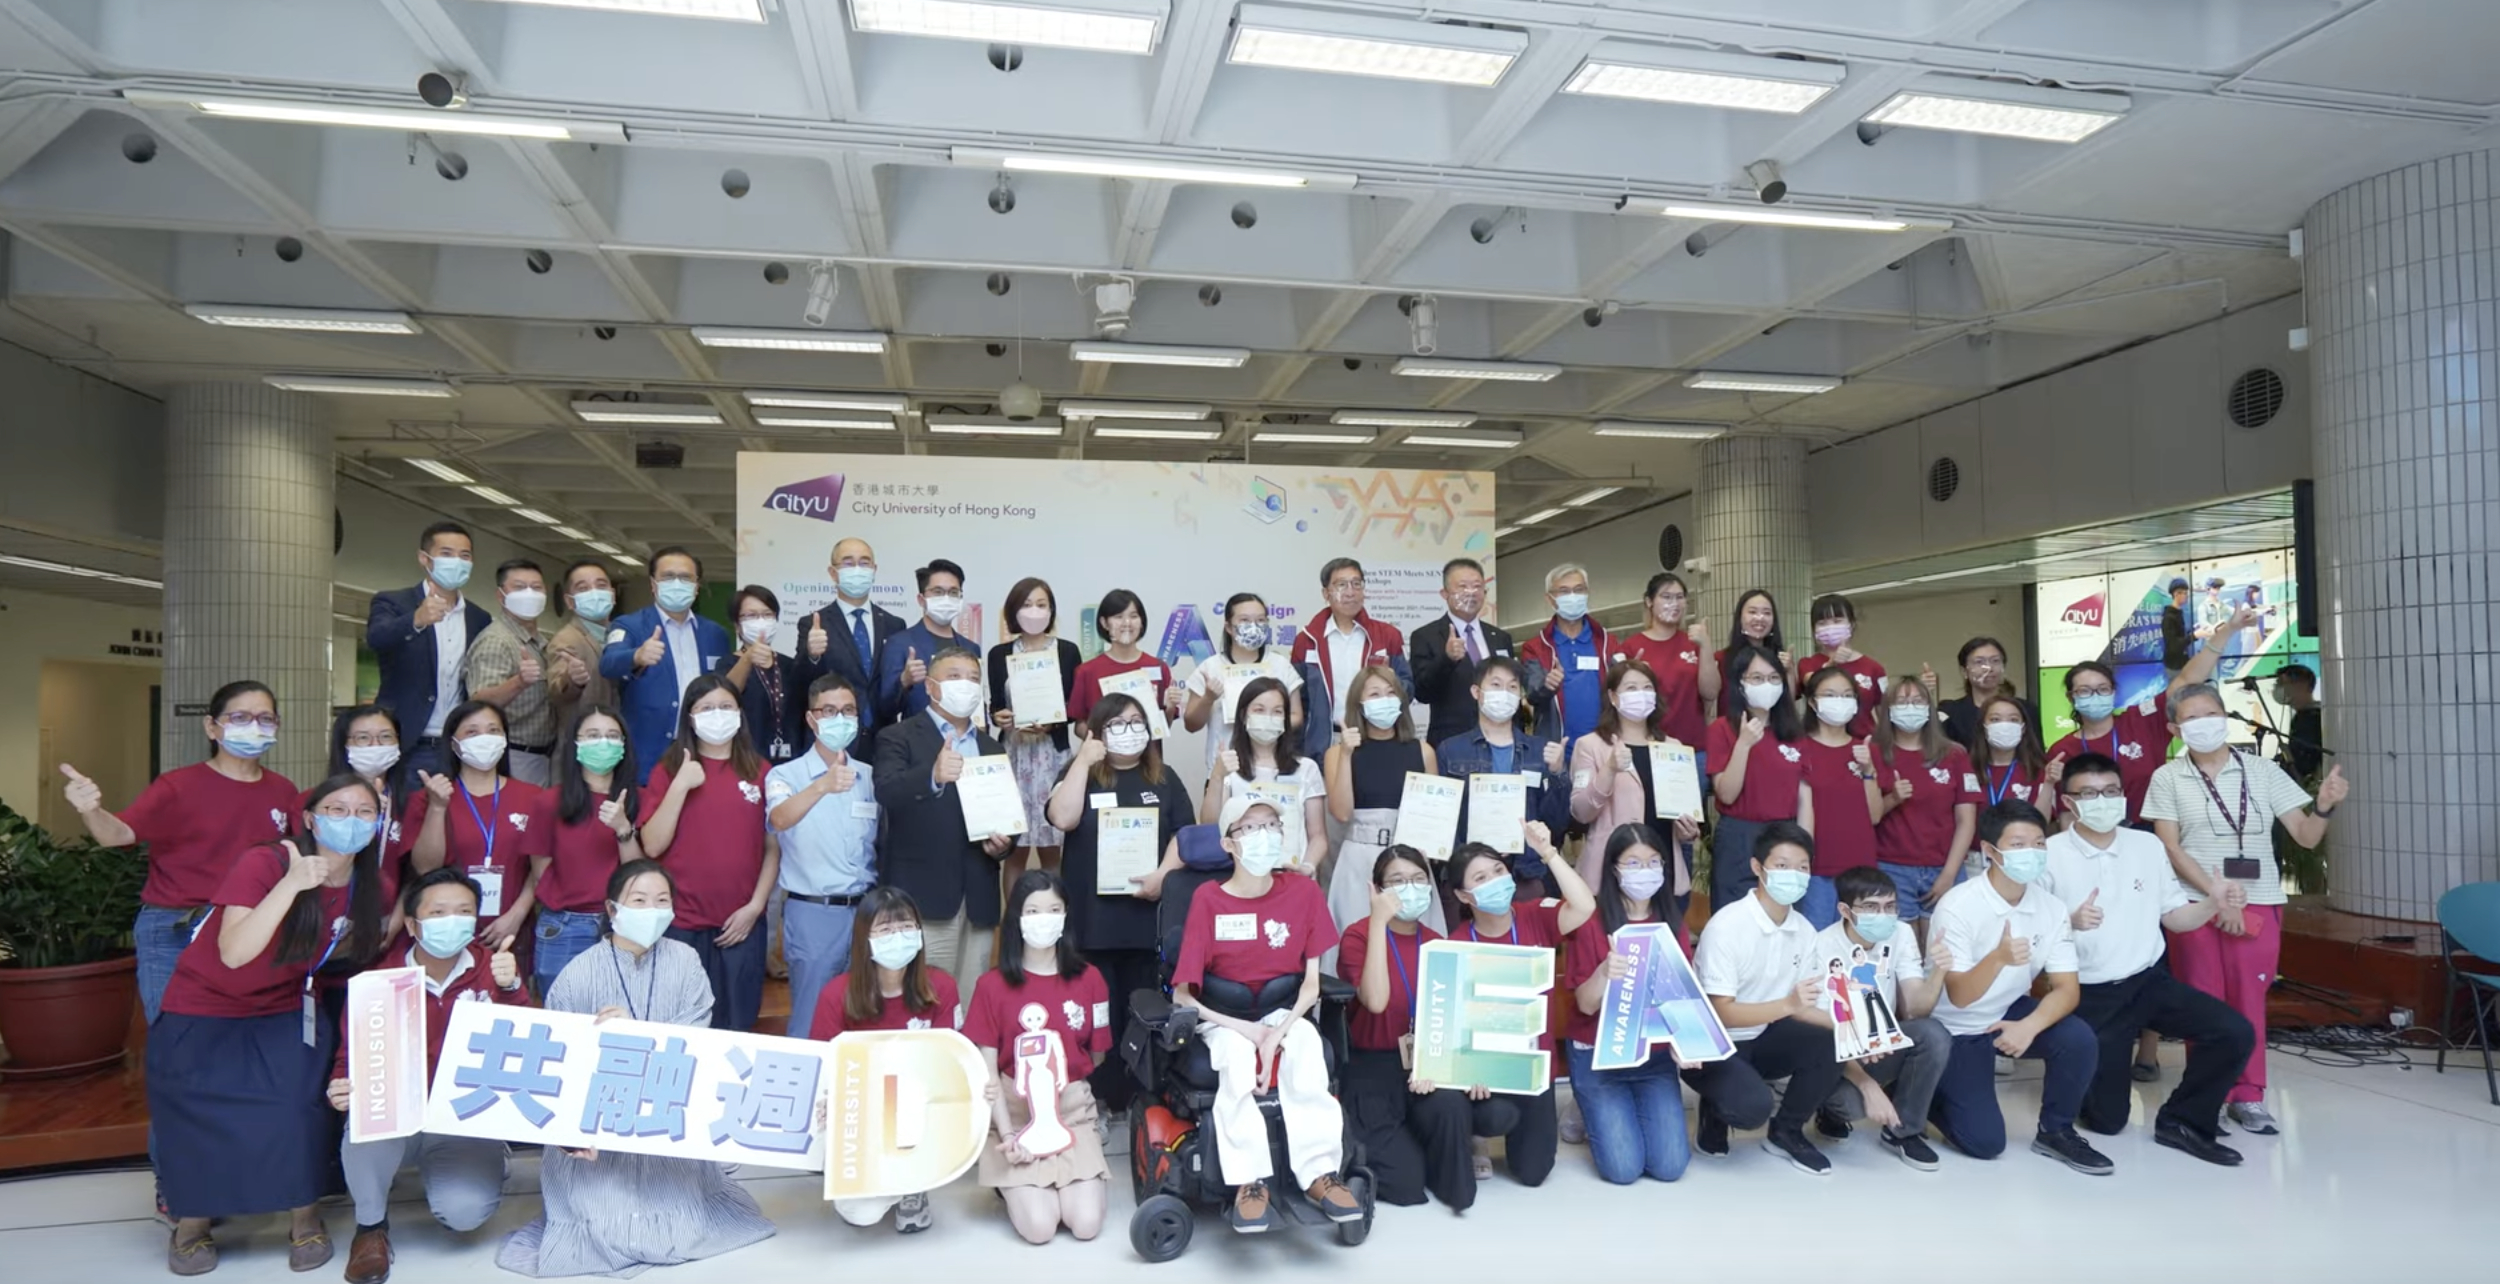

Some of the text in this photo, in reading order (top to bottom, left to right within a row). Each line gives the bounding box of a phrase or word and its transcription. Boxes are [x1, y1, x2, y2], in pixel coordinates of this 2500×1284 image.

[772, 493, 829, 516] CityU
[852, 483, 939, 496] 香港城市大學
[852, 502, 1036, 519] City University of Hong Kong
[2065, 608, 2098, 625] CityU
[1429, 979, 1447, 1058] EQUITY
[1611, 942, 1641, 1057] AWARENESS
[369, 999, 386, 1121] INCLUSION
[449, 1018, 823, 1154] 共融週
[842, 1059, 861, 1180] DIVERSITY
